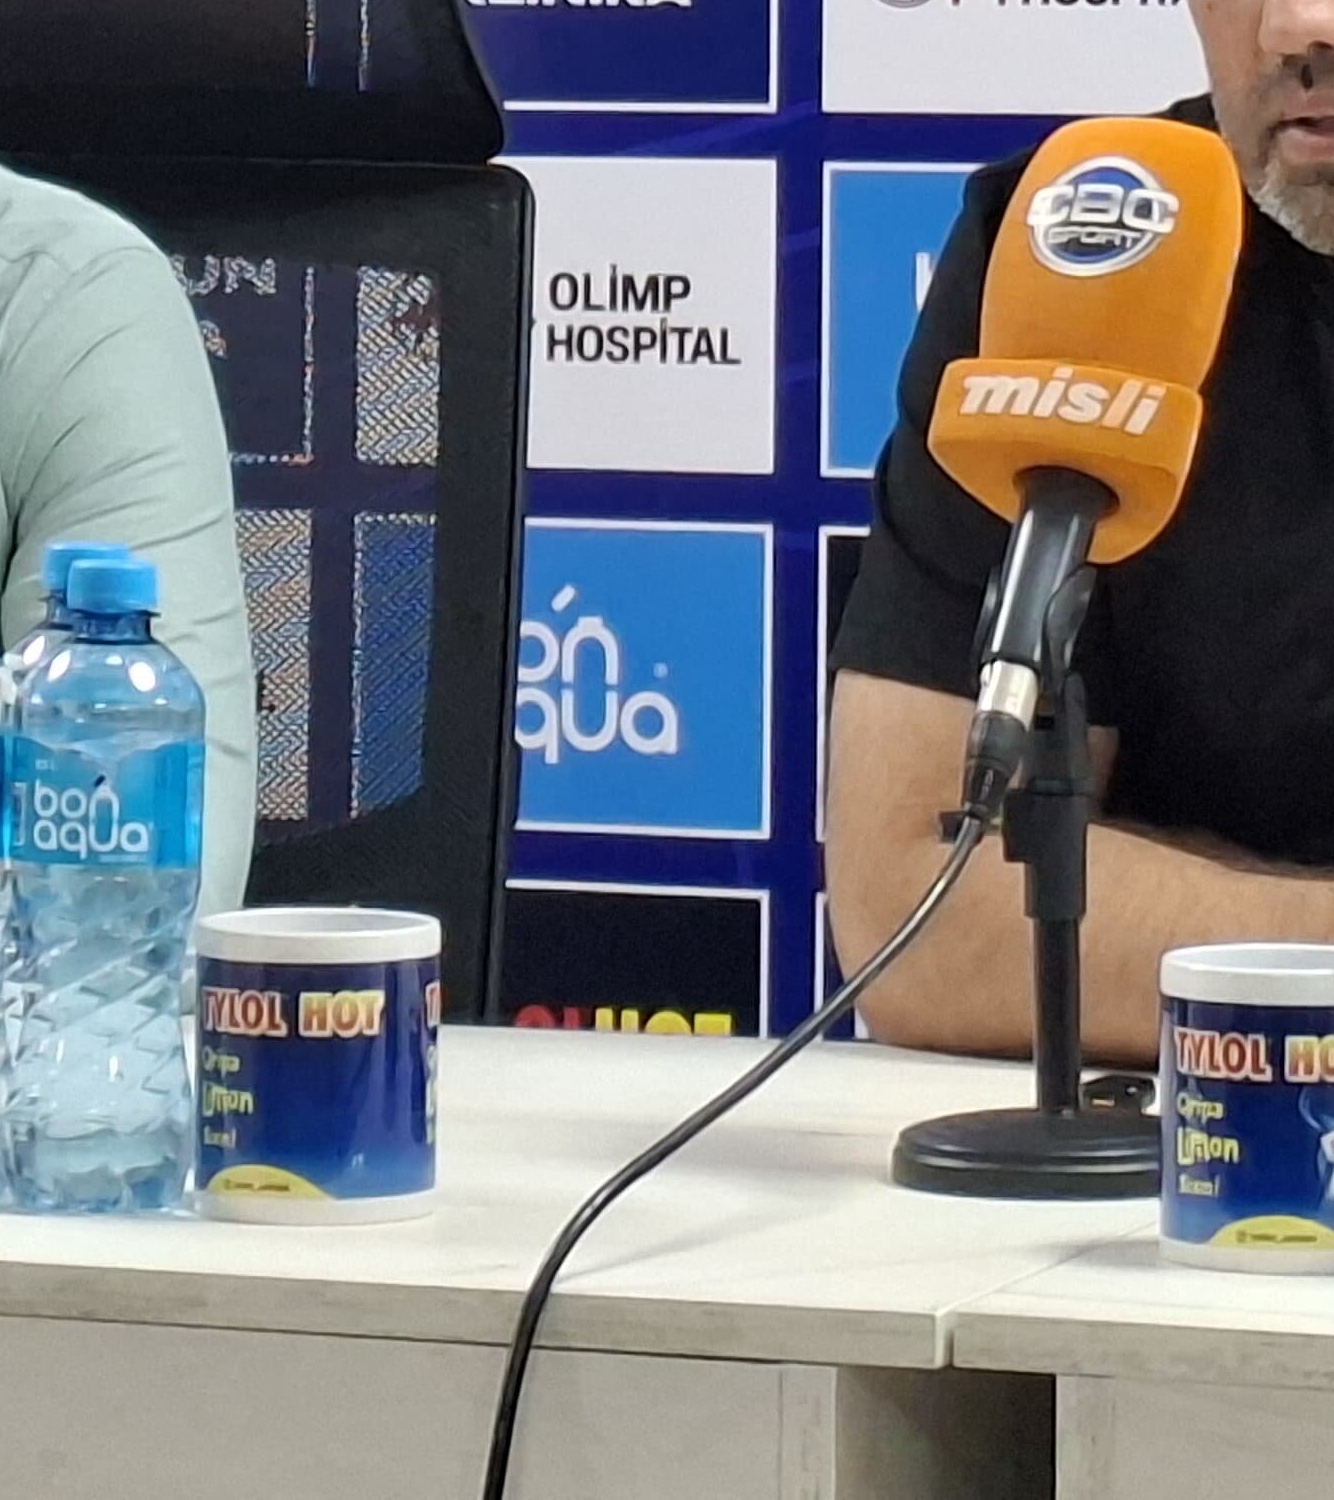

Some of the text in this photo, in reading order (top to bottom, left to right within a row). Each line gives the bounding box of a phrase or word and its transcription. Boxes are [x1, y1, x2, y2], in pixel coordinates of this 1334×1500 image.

[1027, 183, 1180, 235] CBC
[959, 366, 1166, 437] misli
[514, 688, 678, 764] qua
[33, 819, 149, 860] aqua
[298, 989, 385, 1038] HOT
[1173, 1027, 1273, 1082] TYLOL
